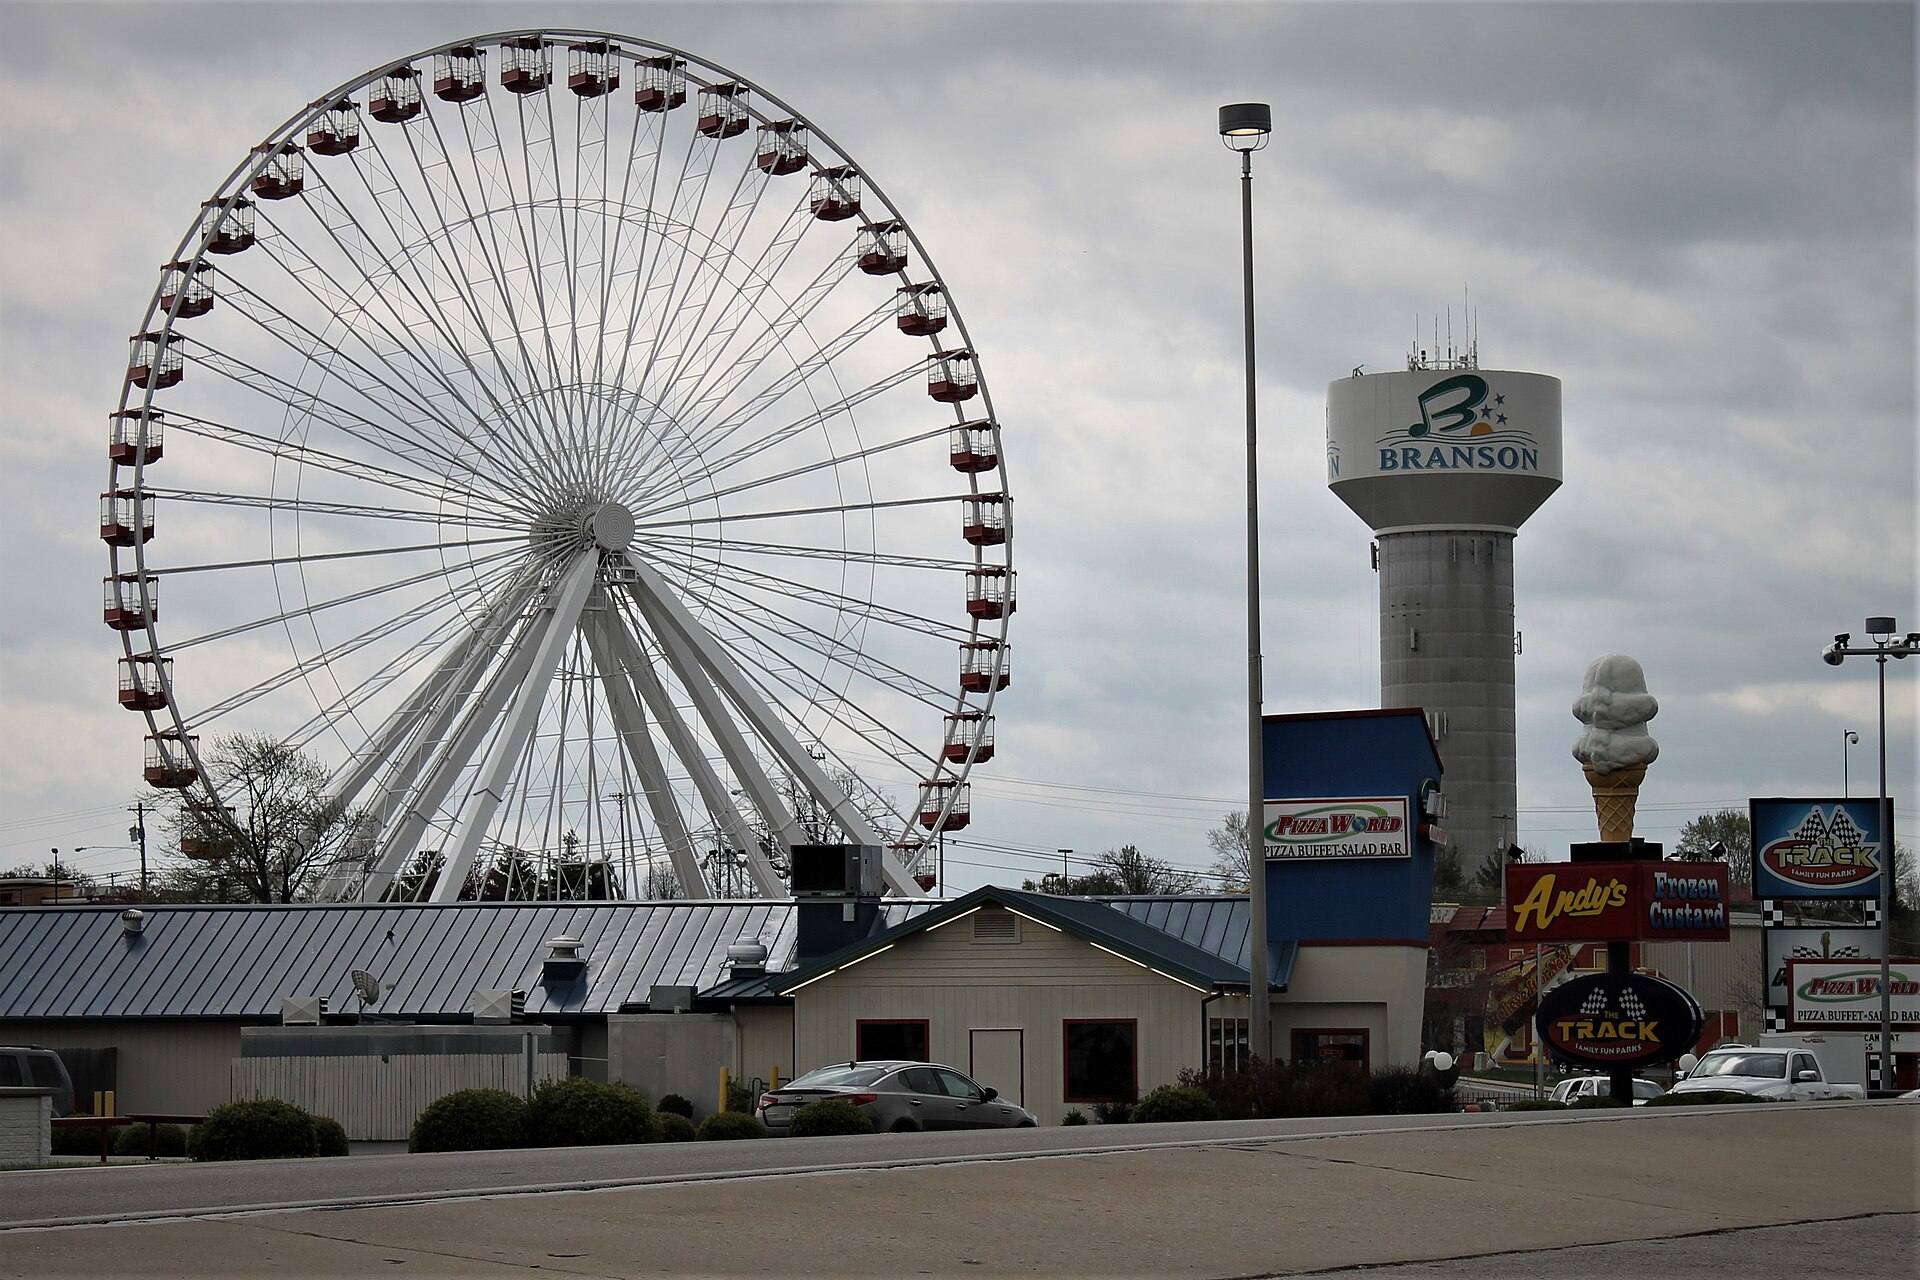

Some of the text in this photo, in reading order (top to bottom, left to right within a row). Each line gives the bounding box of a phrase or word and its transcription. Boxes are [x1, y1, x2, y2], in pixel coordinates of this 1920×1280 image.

[1379, 446, 1538, 472] BRANSON
[1275, 815, 1328, 835] PIZZA
[1264, 845, 1294, 857] PIZZA
[1380, 842, 1402, 855] BAR
[1818, 838, 1834, 846] THE
[1773, 847, 1876, 868] TRACK
[1791, 868, 1815, 878] FAMILY
[1831, 869, 1856, 878] PARKS
[1654, 871, 1720, 900] Frozen
[1513, 873, 1628, 932] Andy's
[1649, 901, 1725, 930] Custard
[1809, 978, 1855, 995] PIZZA
[1604, 1010, 1620, 1019] THE
[1797, 1010, 1920, 1021] PIZZA BUFFET SALD BAR
[1556, 1021, 1661, 1043] TRACK
[1865, 1033, 1880, 1042] CAN
[1575, 1043, 1642, 1055] FAMILY FUN PARKS
